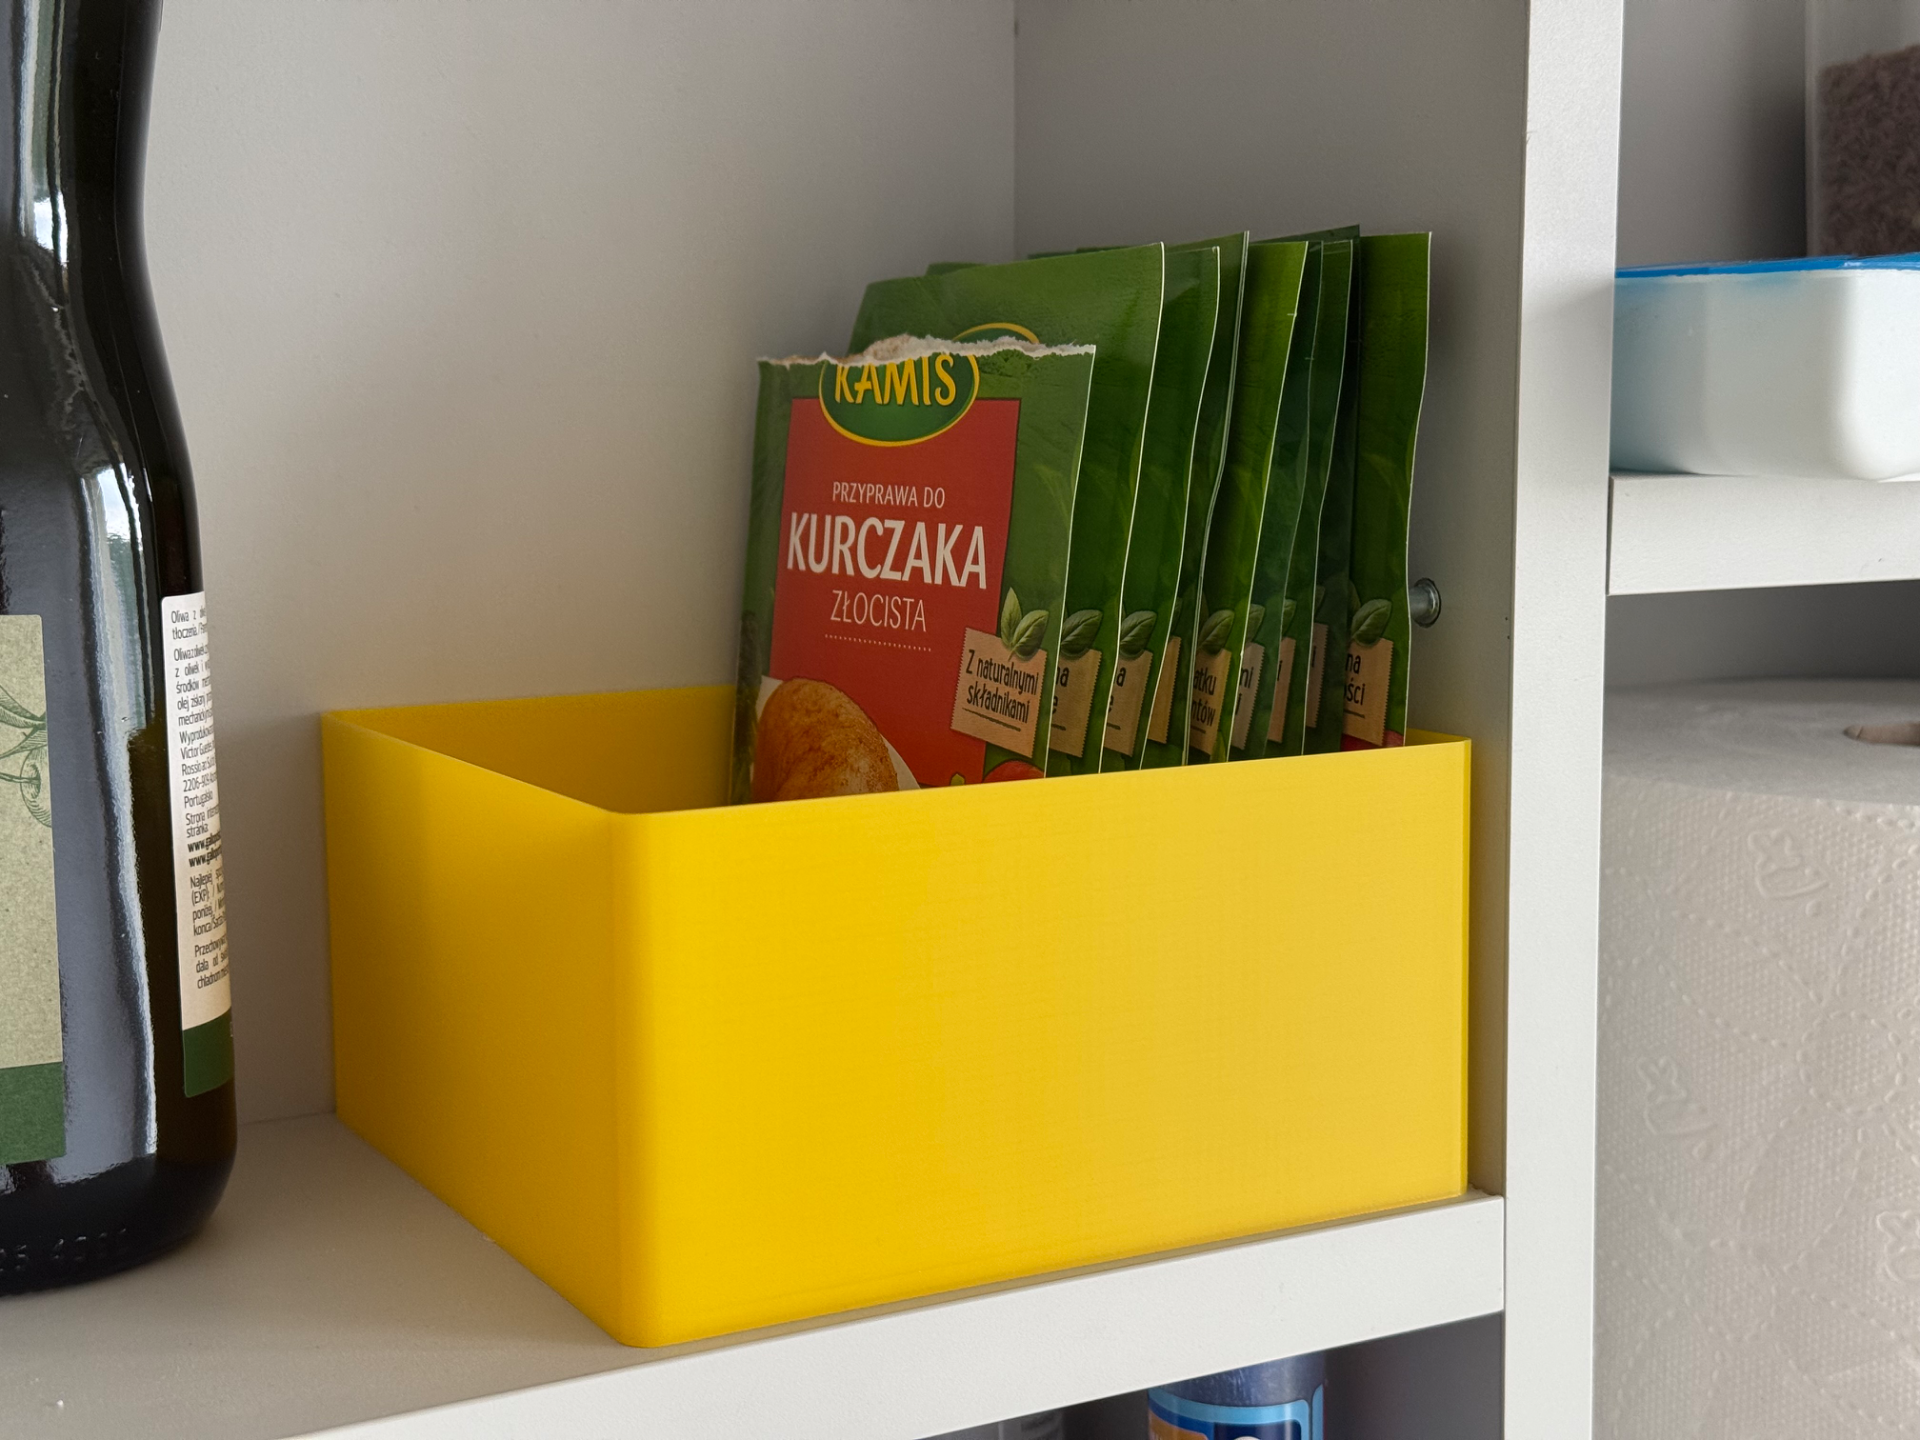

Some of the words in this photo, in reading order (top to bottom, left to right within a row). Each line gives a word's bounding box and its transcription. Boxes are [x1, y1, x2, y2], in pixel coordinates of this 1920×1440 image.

[834, 354, 957, 406] KAMIS
[832, 480, 919, 507] PRZYPRAWA
[923, 486, 946, 509] DO
[786, 511, 988, 590] KURCZAKA
[170, 608, 190, 624] Oliwa
[829, 589, 928, 633] ZŁOCISTA
[965, 648, 976, 675] Z
[976, 657, 1040, 696] naturalnymi
[966, 680, 1031, 724] składnikami
